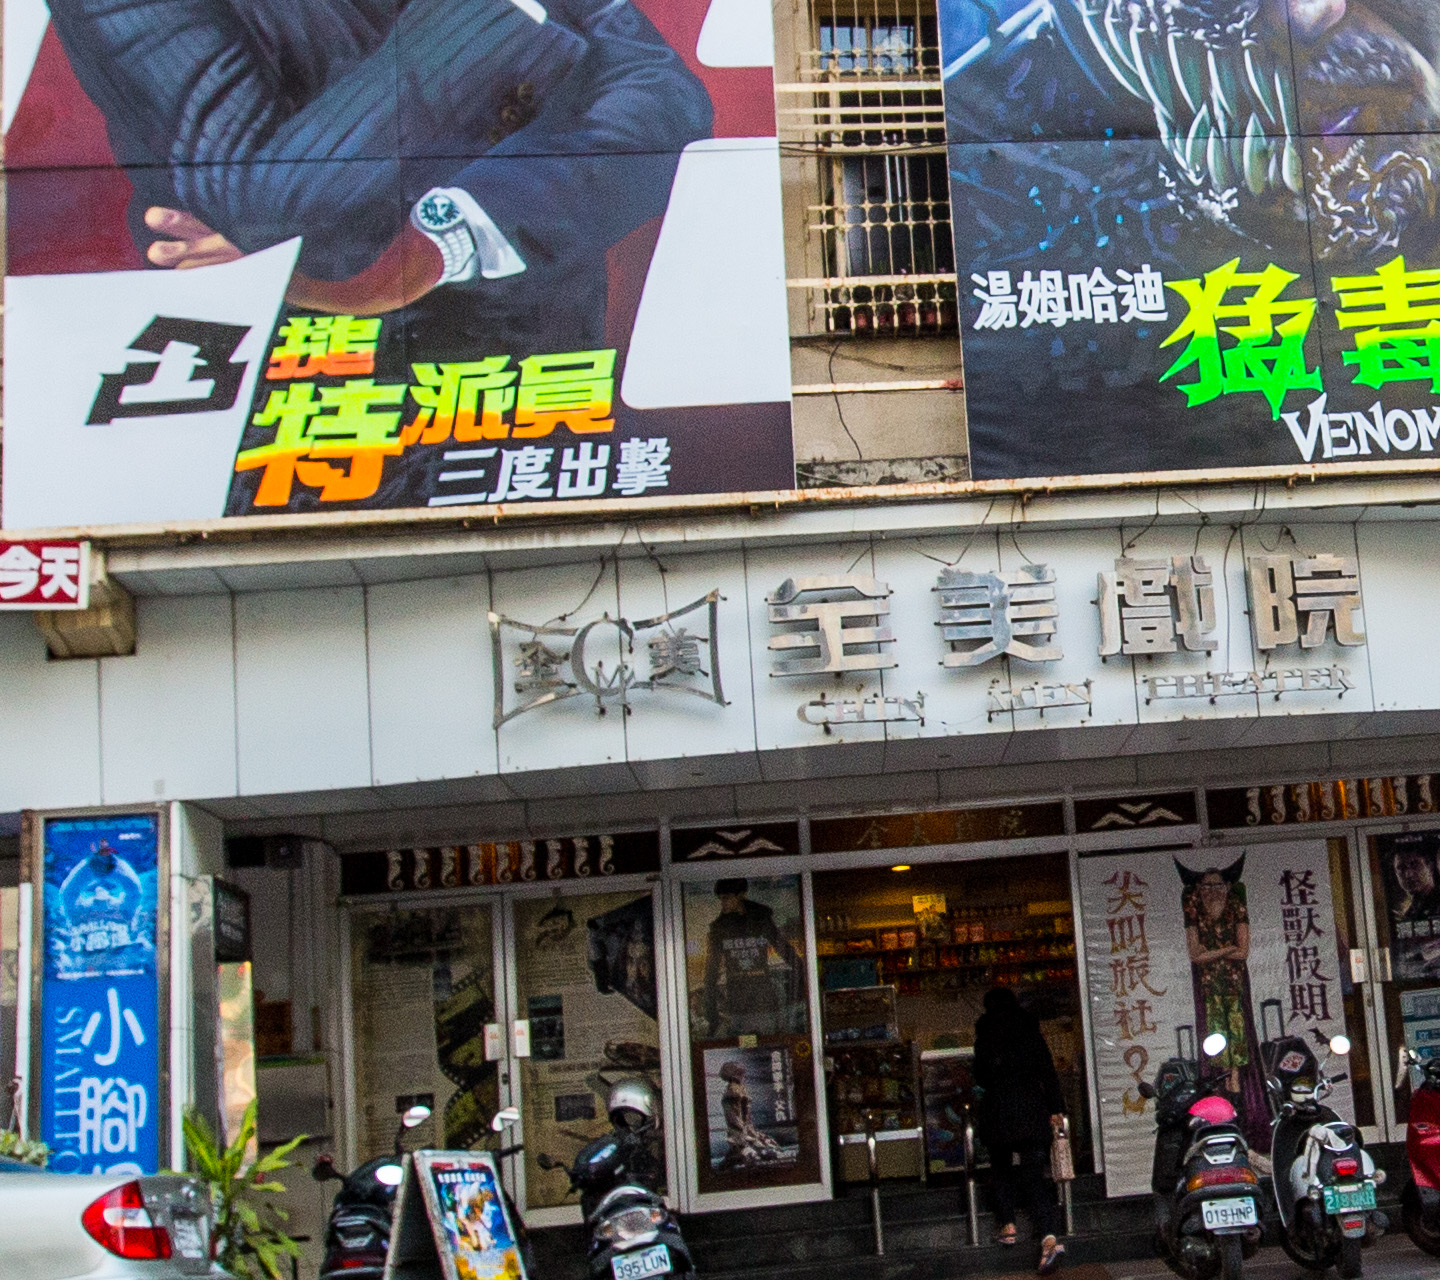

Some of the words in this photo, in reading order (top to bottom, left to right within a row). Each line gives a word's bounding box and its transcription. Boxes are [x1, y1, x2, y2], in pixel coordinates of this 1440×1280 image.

[970, 263, 1168, 331] 湯姆哈迪
[235, 348, 617, 507] 特派員
[427, 435, 672, 508] 三度出擊
[765, 552, 1368, 679] 全美戲院
[1145, 667, 1357, 699] THEATER
[1278, 869, 1334, 1022] 怪獸假期
[80, 987, 148, 1175] 小腳
[1204, 1206, 1254, 1227] 019-HNP
[616, 1254, 669, 1280] 395-LUN
